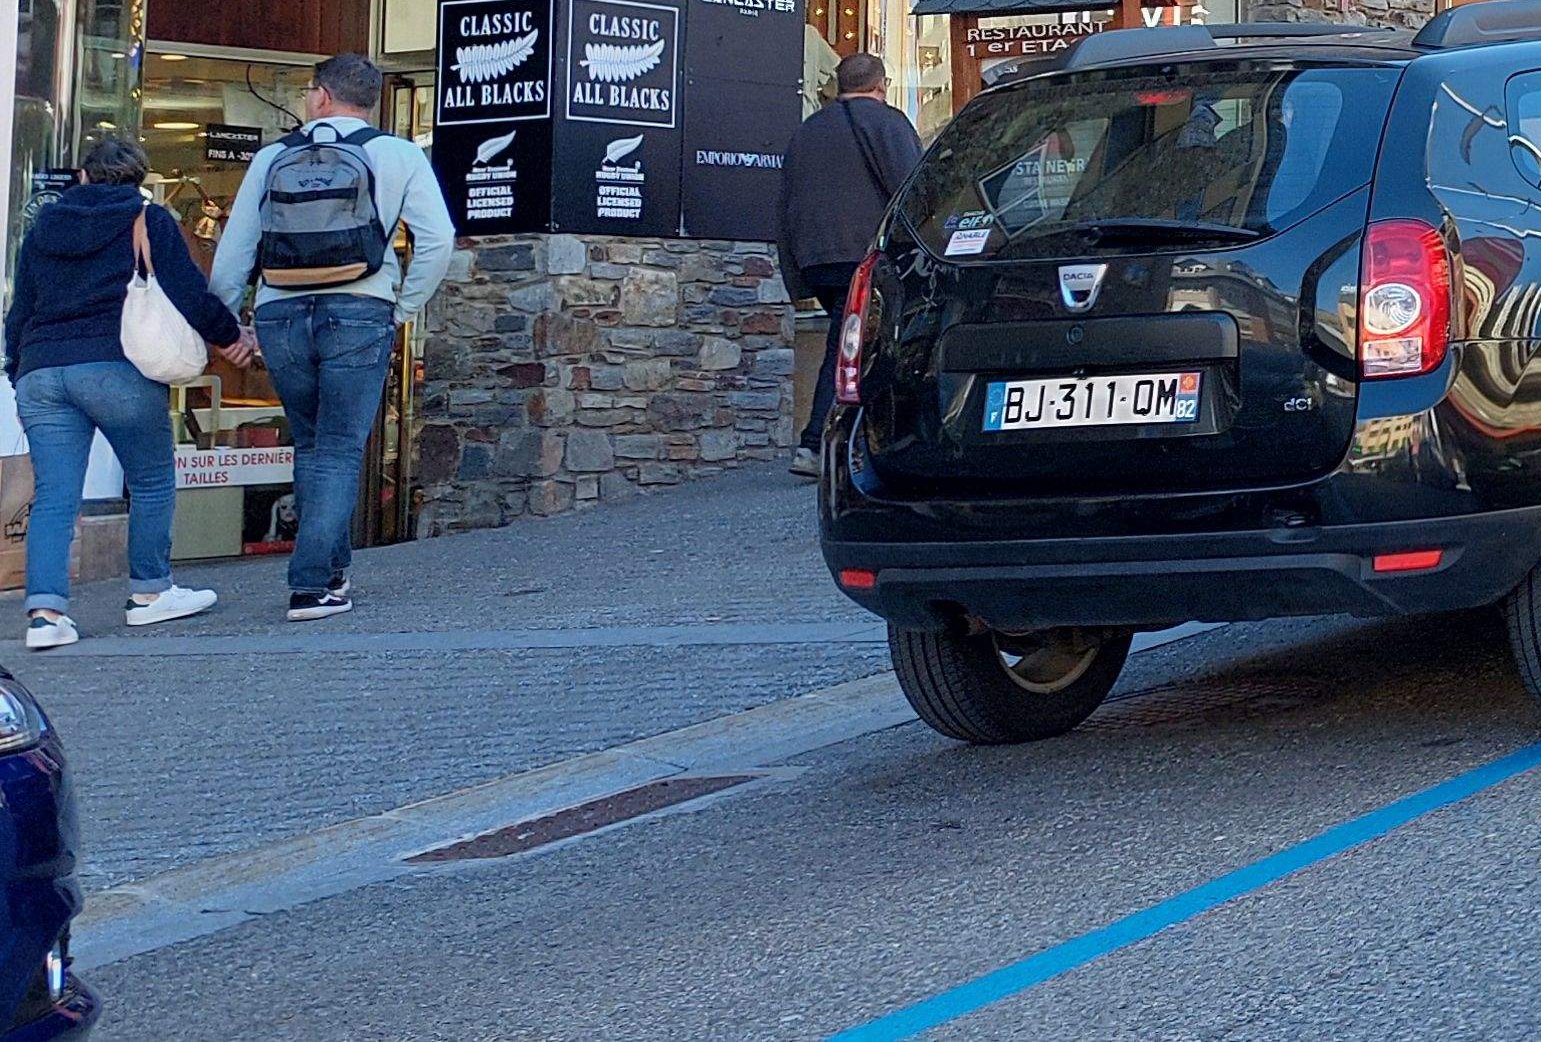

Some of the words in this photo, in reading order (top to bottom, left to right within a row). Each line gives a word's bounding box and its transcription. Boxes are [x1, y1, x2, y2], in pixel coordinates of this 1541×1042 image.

[460, 11, 533, 37] CLASSIC
[589, 13, 660, 41] CLASSIC
[967, 20, 1108, 42] RESTAURANT
[966, 44, 976, 57] 1
[988, 42, 1014, 53] er
[1021, 37, 1079, 54] ETA
[444, 84, 475, 109] ALL
[481, 79, 545, 106] BLACKS
[573, 82, 604, 106] ALL
[609, 84, 670, 112] BLACKS
[696, 149, 742, 166] EMPORIO
[468, 185, 513, 198] OFFICIAL
[598, 185, 643, 198] OFFICIAL
[466, 196, 514, 209] LICENSED
[597, 196, 642, 208] LICENSED
[467, 207, 513, 220] PRODUCT
[597, 207, 641, 219] PRODUCT
[1063, 271, 1094, 282] DACIA
[1176, 399, 1195, 418] 82
[191, 455, 215, 468] SUR
[218, 454, 238, 467] LES
[184, 471, 229, 486] TAILLES
